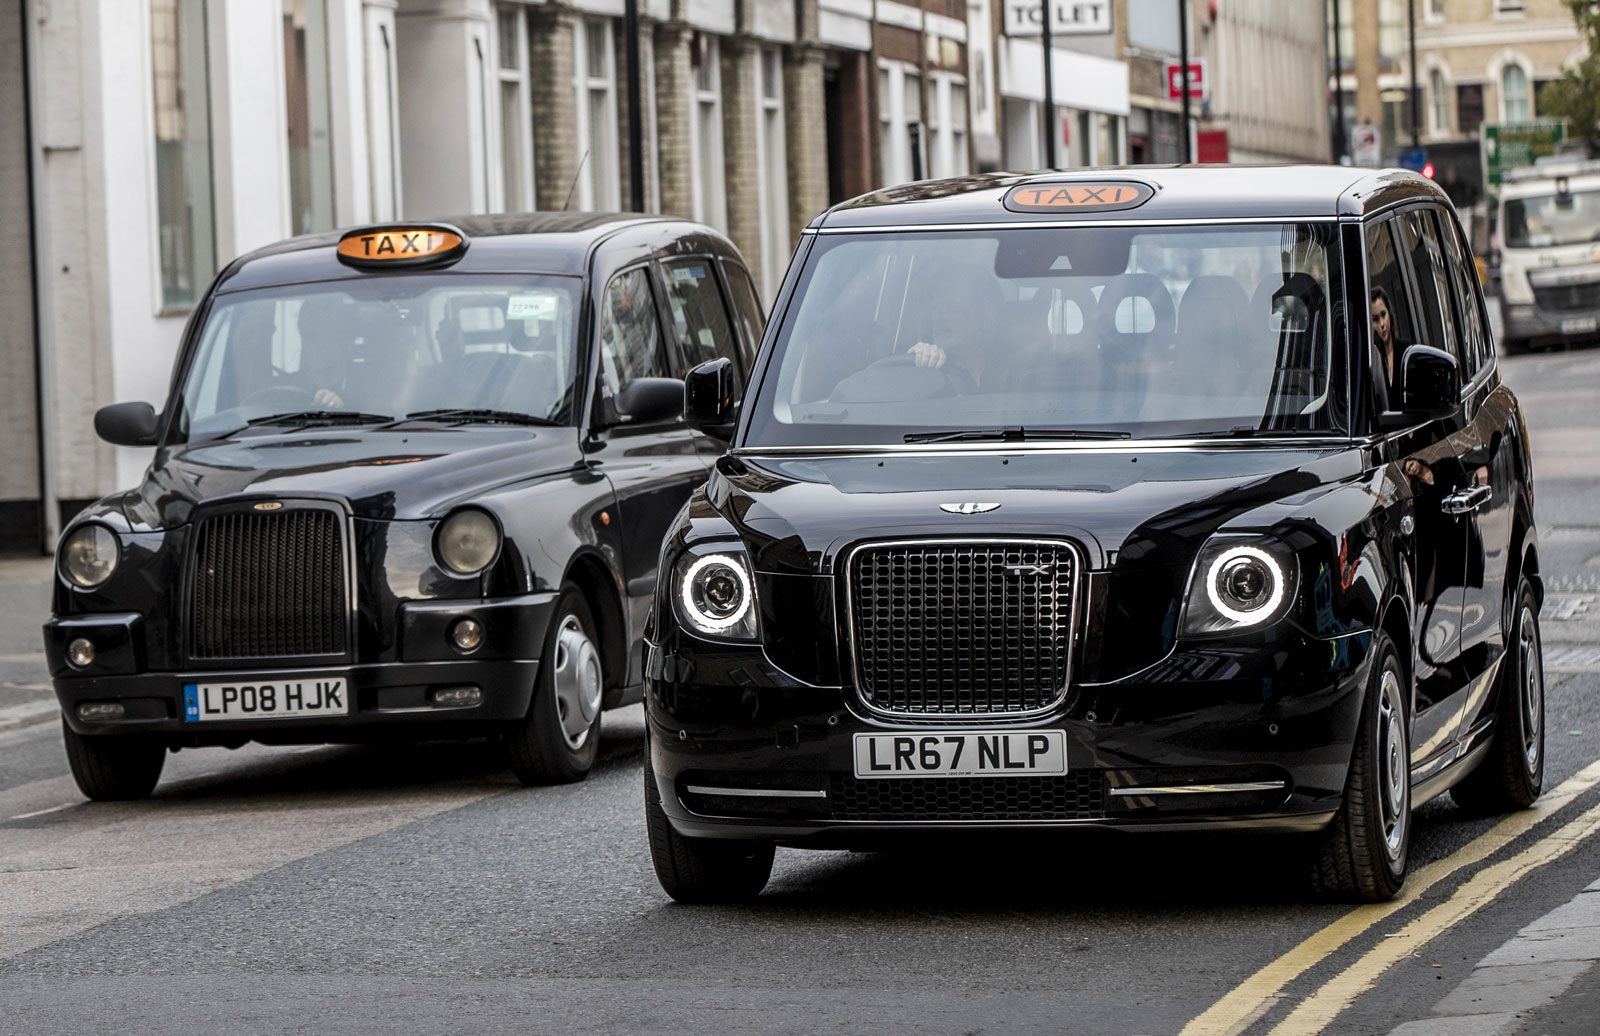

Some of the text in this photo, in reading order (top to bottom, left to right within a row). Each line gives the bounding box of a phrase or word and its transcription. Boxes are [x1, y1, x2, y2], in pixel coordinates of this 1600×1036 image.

[1011, 3, 1104, 25] TO LET
[1028, 188, 1122, 204] TAXI
[360, 233, 433, 256] TAXI
[203, 681, 343, 714] LP08 HJK
[869, 735, 1050, 771] LR67 NLP
